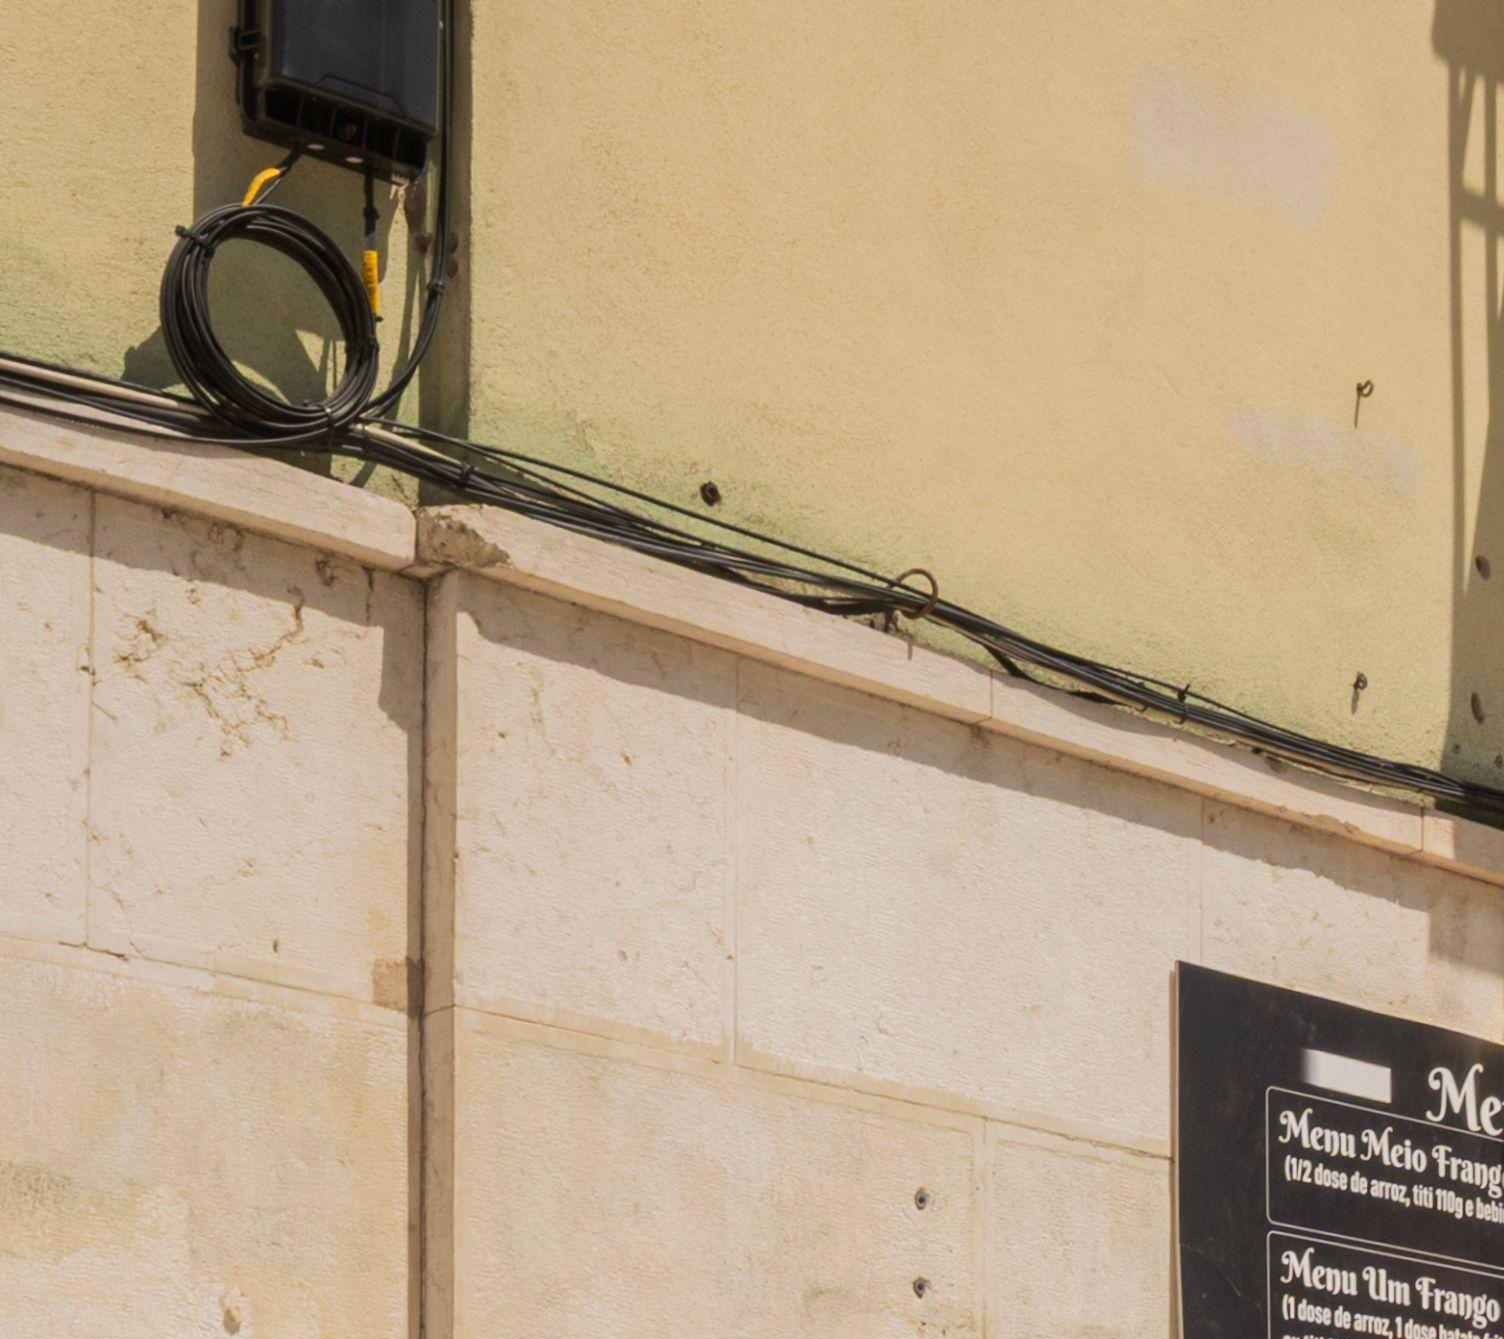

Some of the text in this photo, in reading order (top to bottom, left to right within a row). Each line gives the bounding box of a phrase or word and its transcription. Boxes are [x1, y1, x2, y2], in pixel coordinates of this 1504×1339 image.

[1279, 1108, 1356, 1158] Menu
[1360, 1127, 1427, 1172] Meio
[1285, 1154, 1312, 1183] (1/2
[1314, 1164, 1347, 1190] dose
[1350, 1171, 1367, 1195] de
[1370, 1179, 1410, 1207] arroz,
[1413, 1184, 1432, 1208] titi
[1436, 1188, 1463, 1219] 110g
[1465, 1200, 1473, 1216] e
[1280, 1248, 1500, 1328] Menu Um Frango
[1282, 1294, 1296, 1321] (1
[1298, 1300, 1331, 1328] dose
[1334, 1306, 1350, 1330] de
[1354, 1312, 1393, 1339] arroz,
[1396, 1317, 1402, 1337] 1
